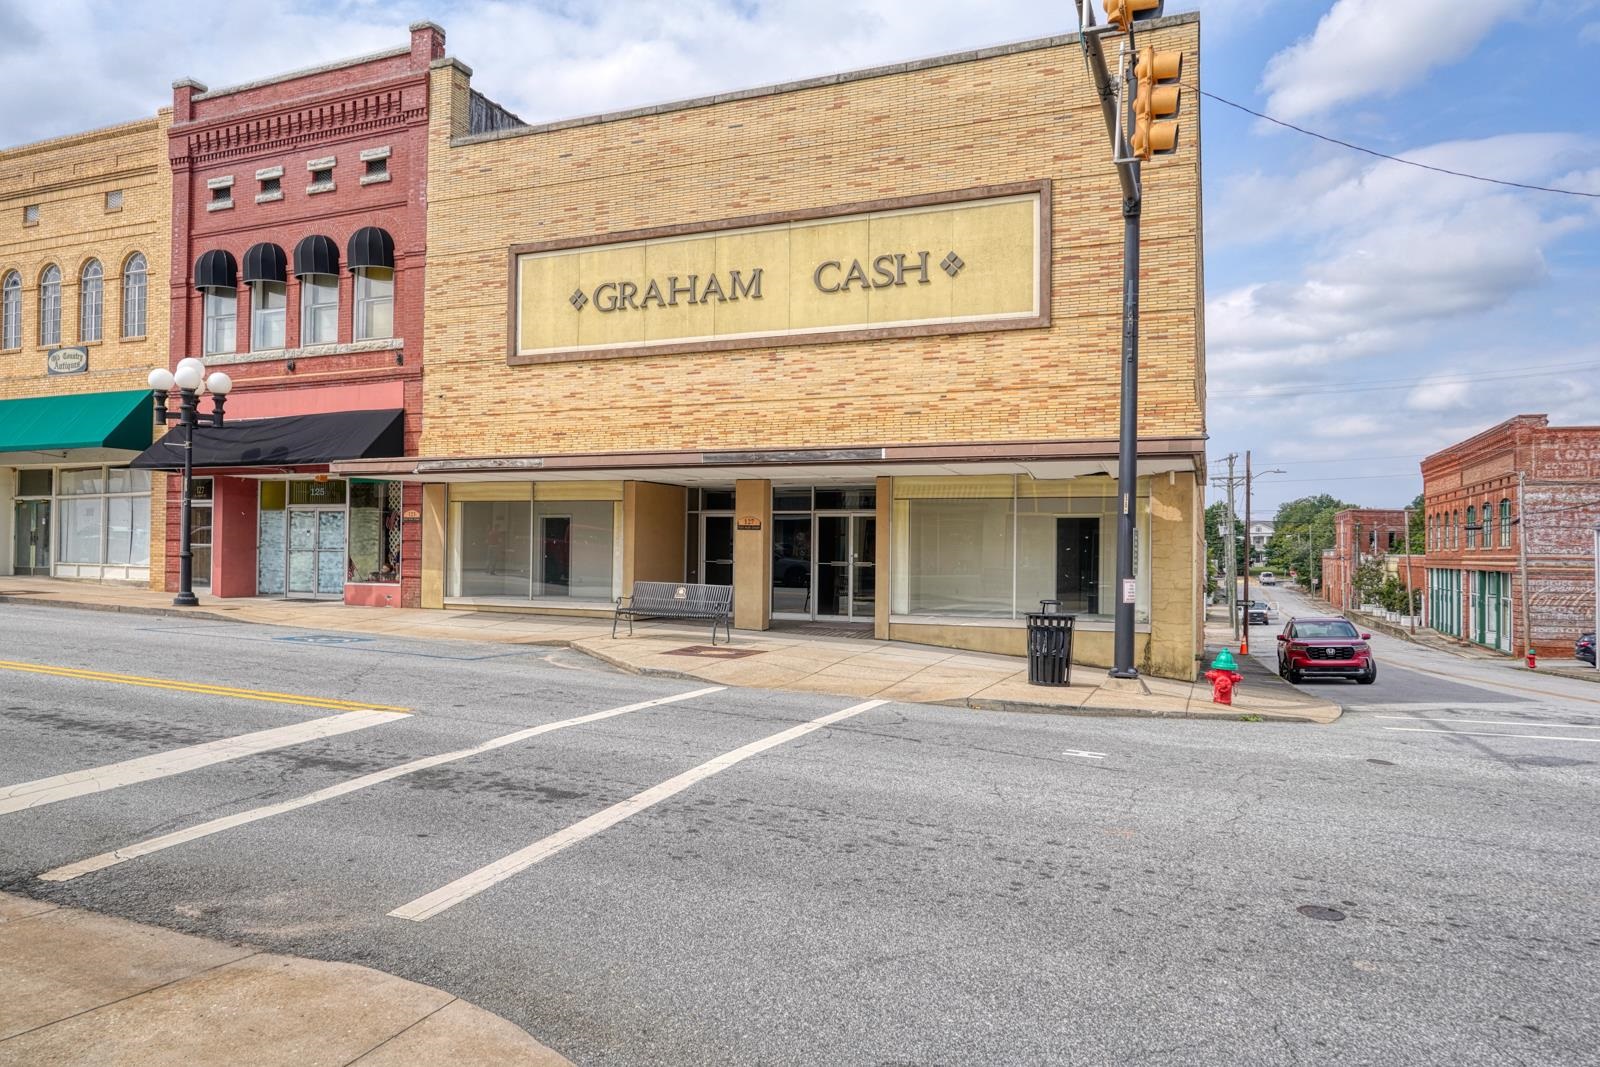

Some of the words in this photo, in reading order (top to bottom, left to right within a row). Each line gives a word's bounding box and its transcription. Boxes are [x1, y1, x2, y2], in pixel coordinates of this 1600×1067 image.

[592, 268, 763, 313] GRAHAM
[813, 251, 930, 293] CASH
[310, 487, 325, 496] 125
